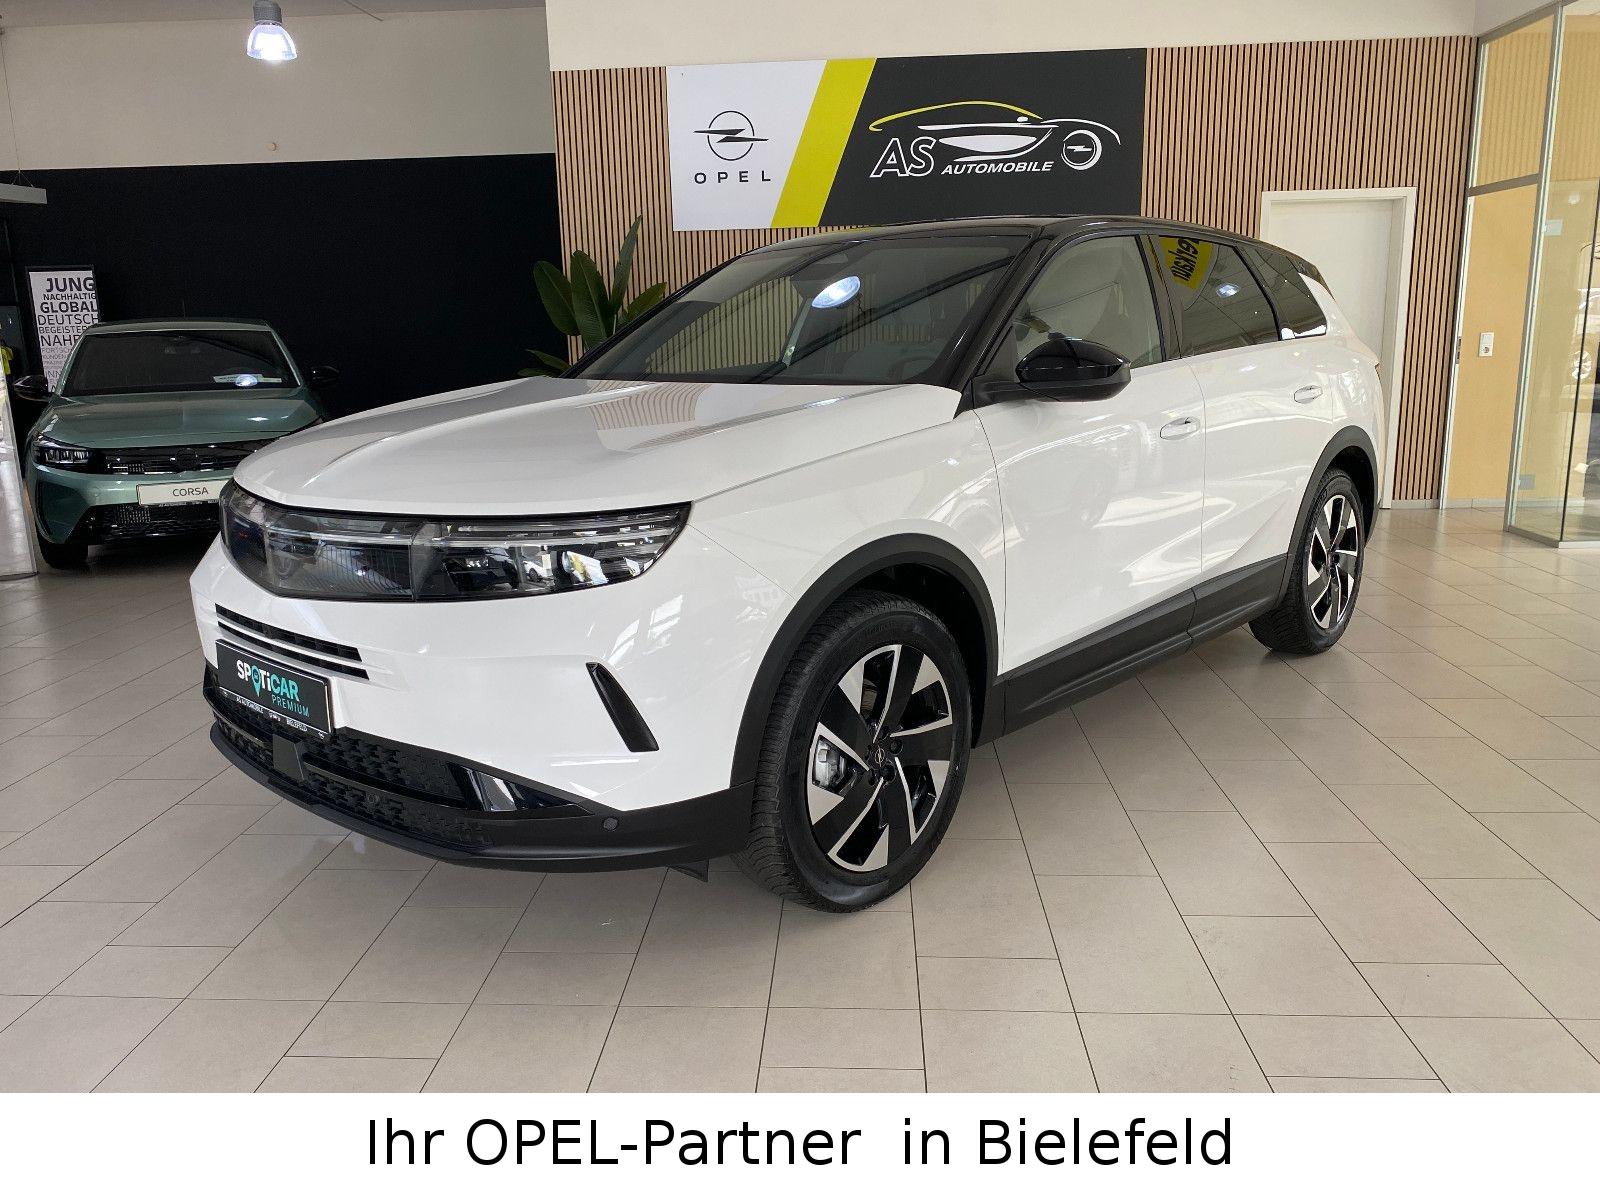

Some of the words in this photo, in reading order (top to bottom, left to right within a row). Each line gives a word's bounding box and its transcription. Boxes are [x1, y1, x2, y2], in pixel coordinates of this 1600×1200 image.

[869, 136, 937, 177] AS
[941, 160, 1055, 175] AUTOMOBILE
[694, 170, 771, 184] OPEL
[45, 277, 96, 292] JUNG
[40, 301, 98, 313] GLOBAL
[172, 486, 209, 497] CORSA
[271, 694, 310, 718] PREMIUM
